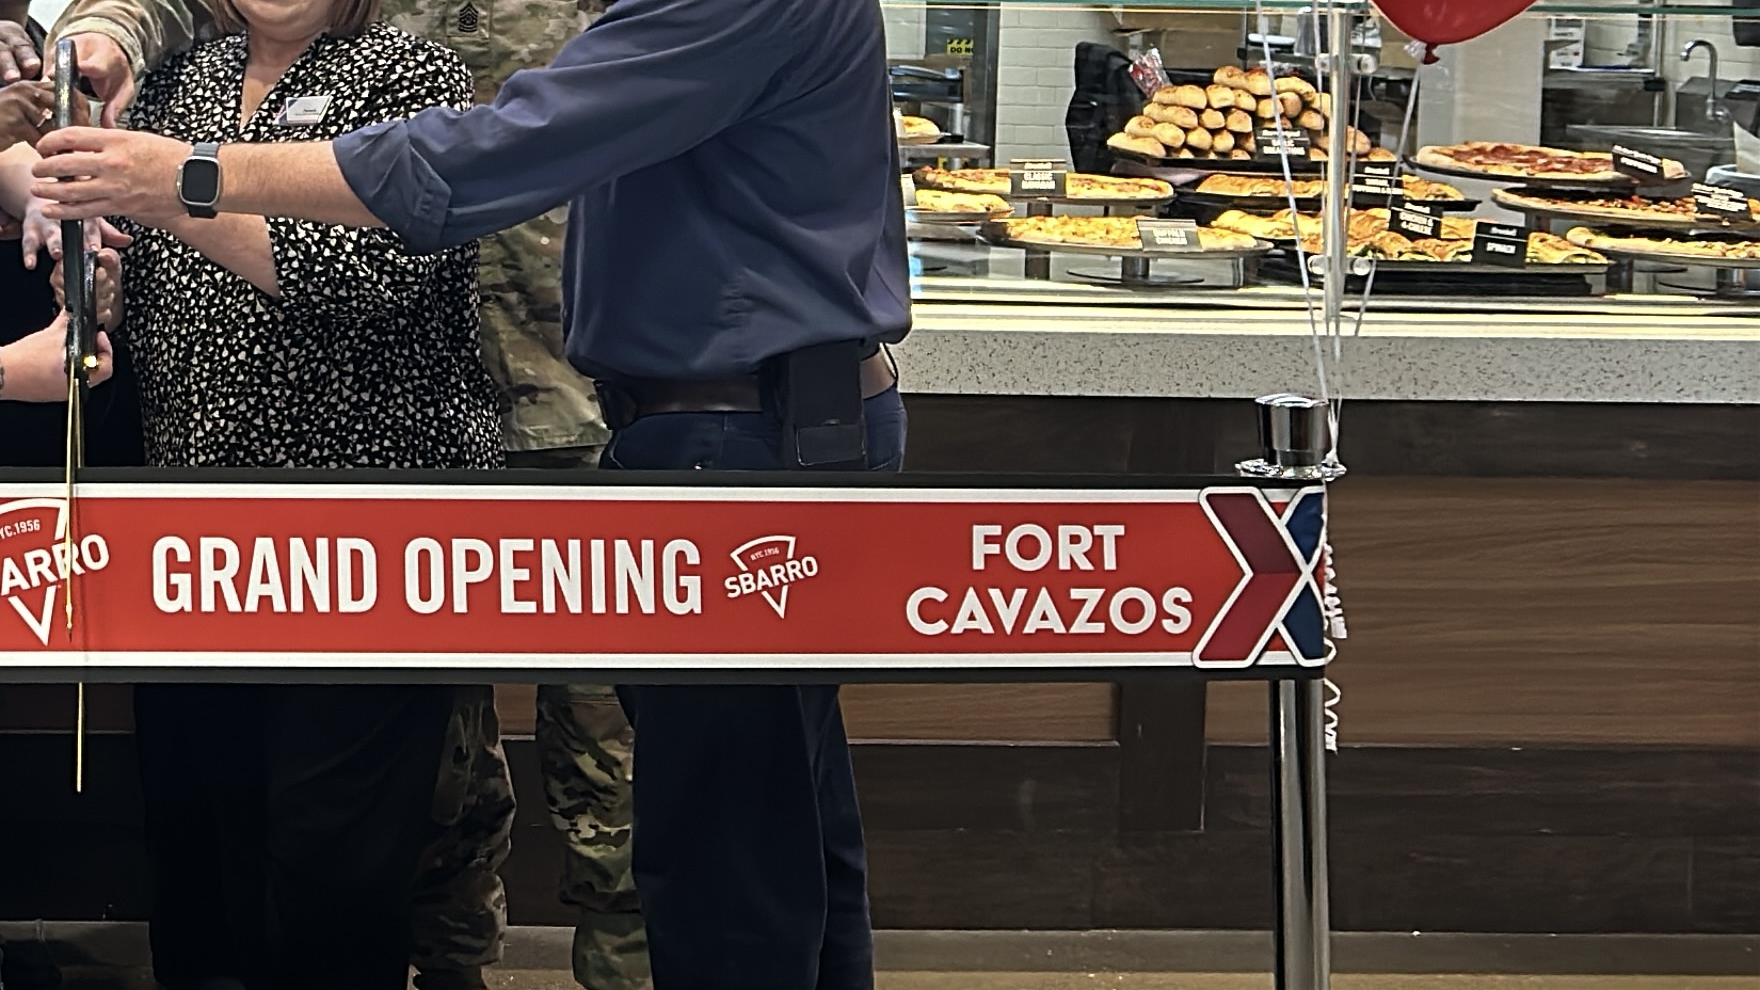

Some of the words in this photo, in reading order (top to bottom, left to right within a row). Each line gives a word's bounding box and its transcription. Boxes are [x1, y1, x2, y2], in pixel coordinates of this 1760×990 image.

[969, 521, 1126, 575] FORT
[148, 533, 380, 617] GRAND
[401, 534, 704, 619] OPENING
[724, 556, 818, 598] SBARRO
[903, 583, 1194, 639] CAVAZOS
